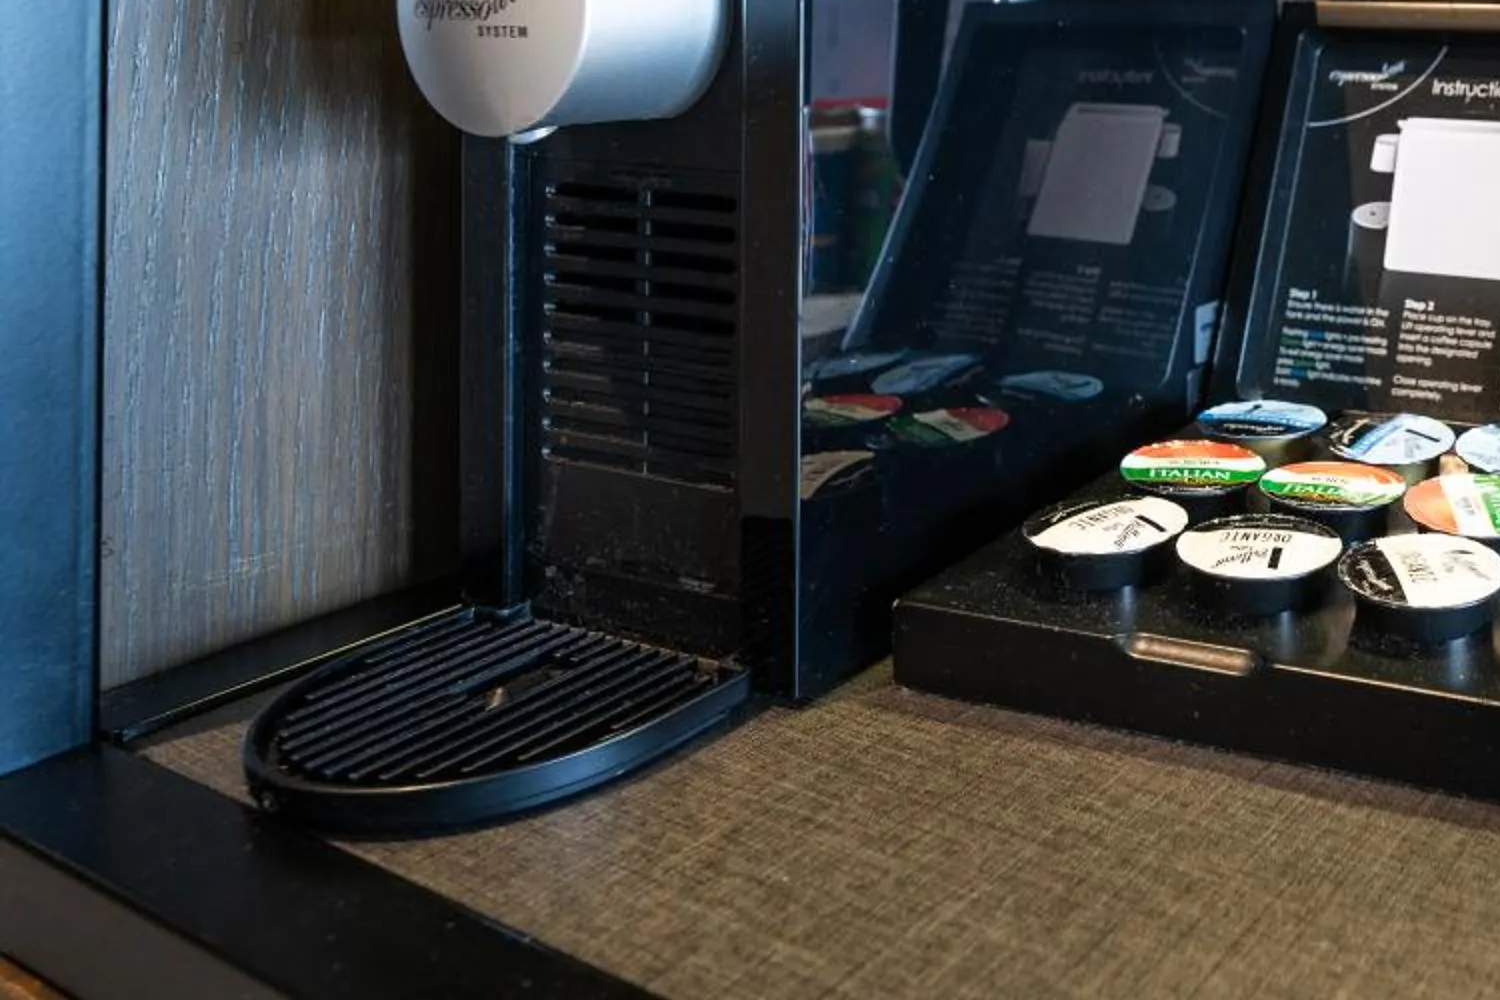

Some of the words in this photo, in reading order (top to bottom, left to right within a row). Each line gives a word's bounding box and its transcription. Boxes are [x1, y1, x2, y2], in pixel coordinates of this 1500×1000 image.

[477, 25, 528, 39] SYSTEM
[1404, 298, 1427, 312] Step
[1148, 467, 1232, 482] ITALIAN
[1220, 531, 1294, 544] ORGANIC
